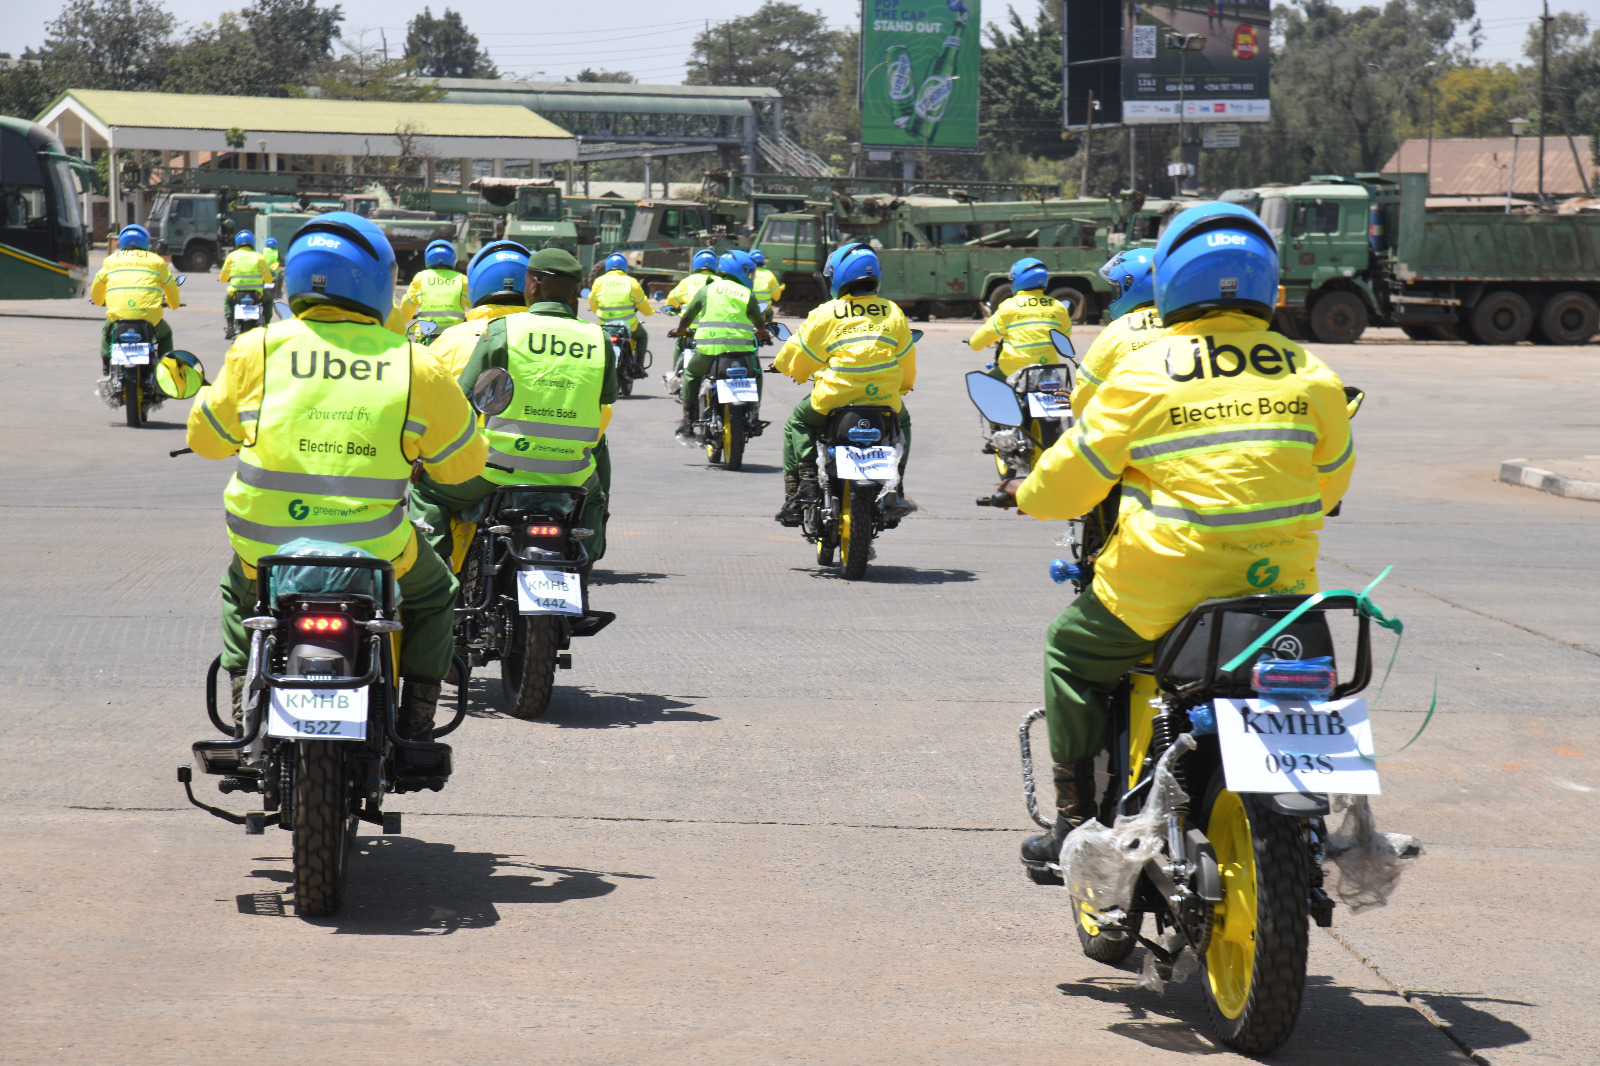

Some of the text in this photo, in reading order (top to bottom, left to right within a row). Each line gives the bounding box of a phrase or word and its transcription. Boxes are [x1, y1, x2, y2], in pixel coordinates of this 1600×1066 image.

[874, 9, 926, 20] THE CAP
[873, 20, 942, 33] STAND OUT
[307, 235, 341, 249] Uber
[1207, 233, 1247, 247] Uber
[495, 252, 520, 260] Uber
[427, 276, 456, 286] Uber
[716, 286, 745, 297] Uber
[834, 298, 888, 320] Uber
[1015, 296, 1055, 308] Uber
[528, 333, 597, 359] Uber
[291, 350, 391, 381] Uber
[1165, 335, 1297, 382] Uber
[307, 406, 355, 421] Powered
[524, 405, 577, 419] Electric Boda
[1170, 396, 1308, 426] Electric Boda
[299, 438, 377, 457] Electric Boda
[529, 581, 569, 592] KMHB
[535, 599, 567, 609] 144Z
[286, 694, 350, 709] KMHB
[293, 720, 342, 735] 152Z
[1242, 713, 1346, 736] KMHB
[1265, 753, 1334, 775] 093S
